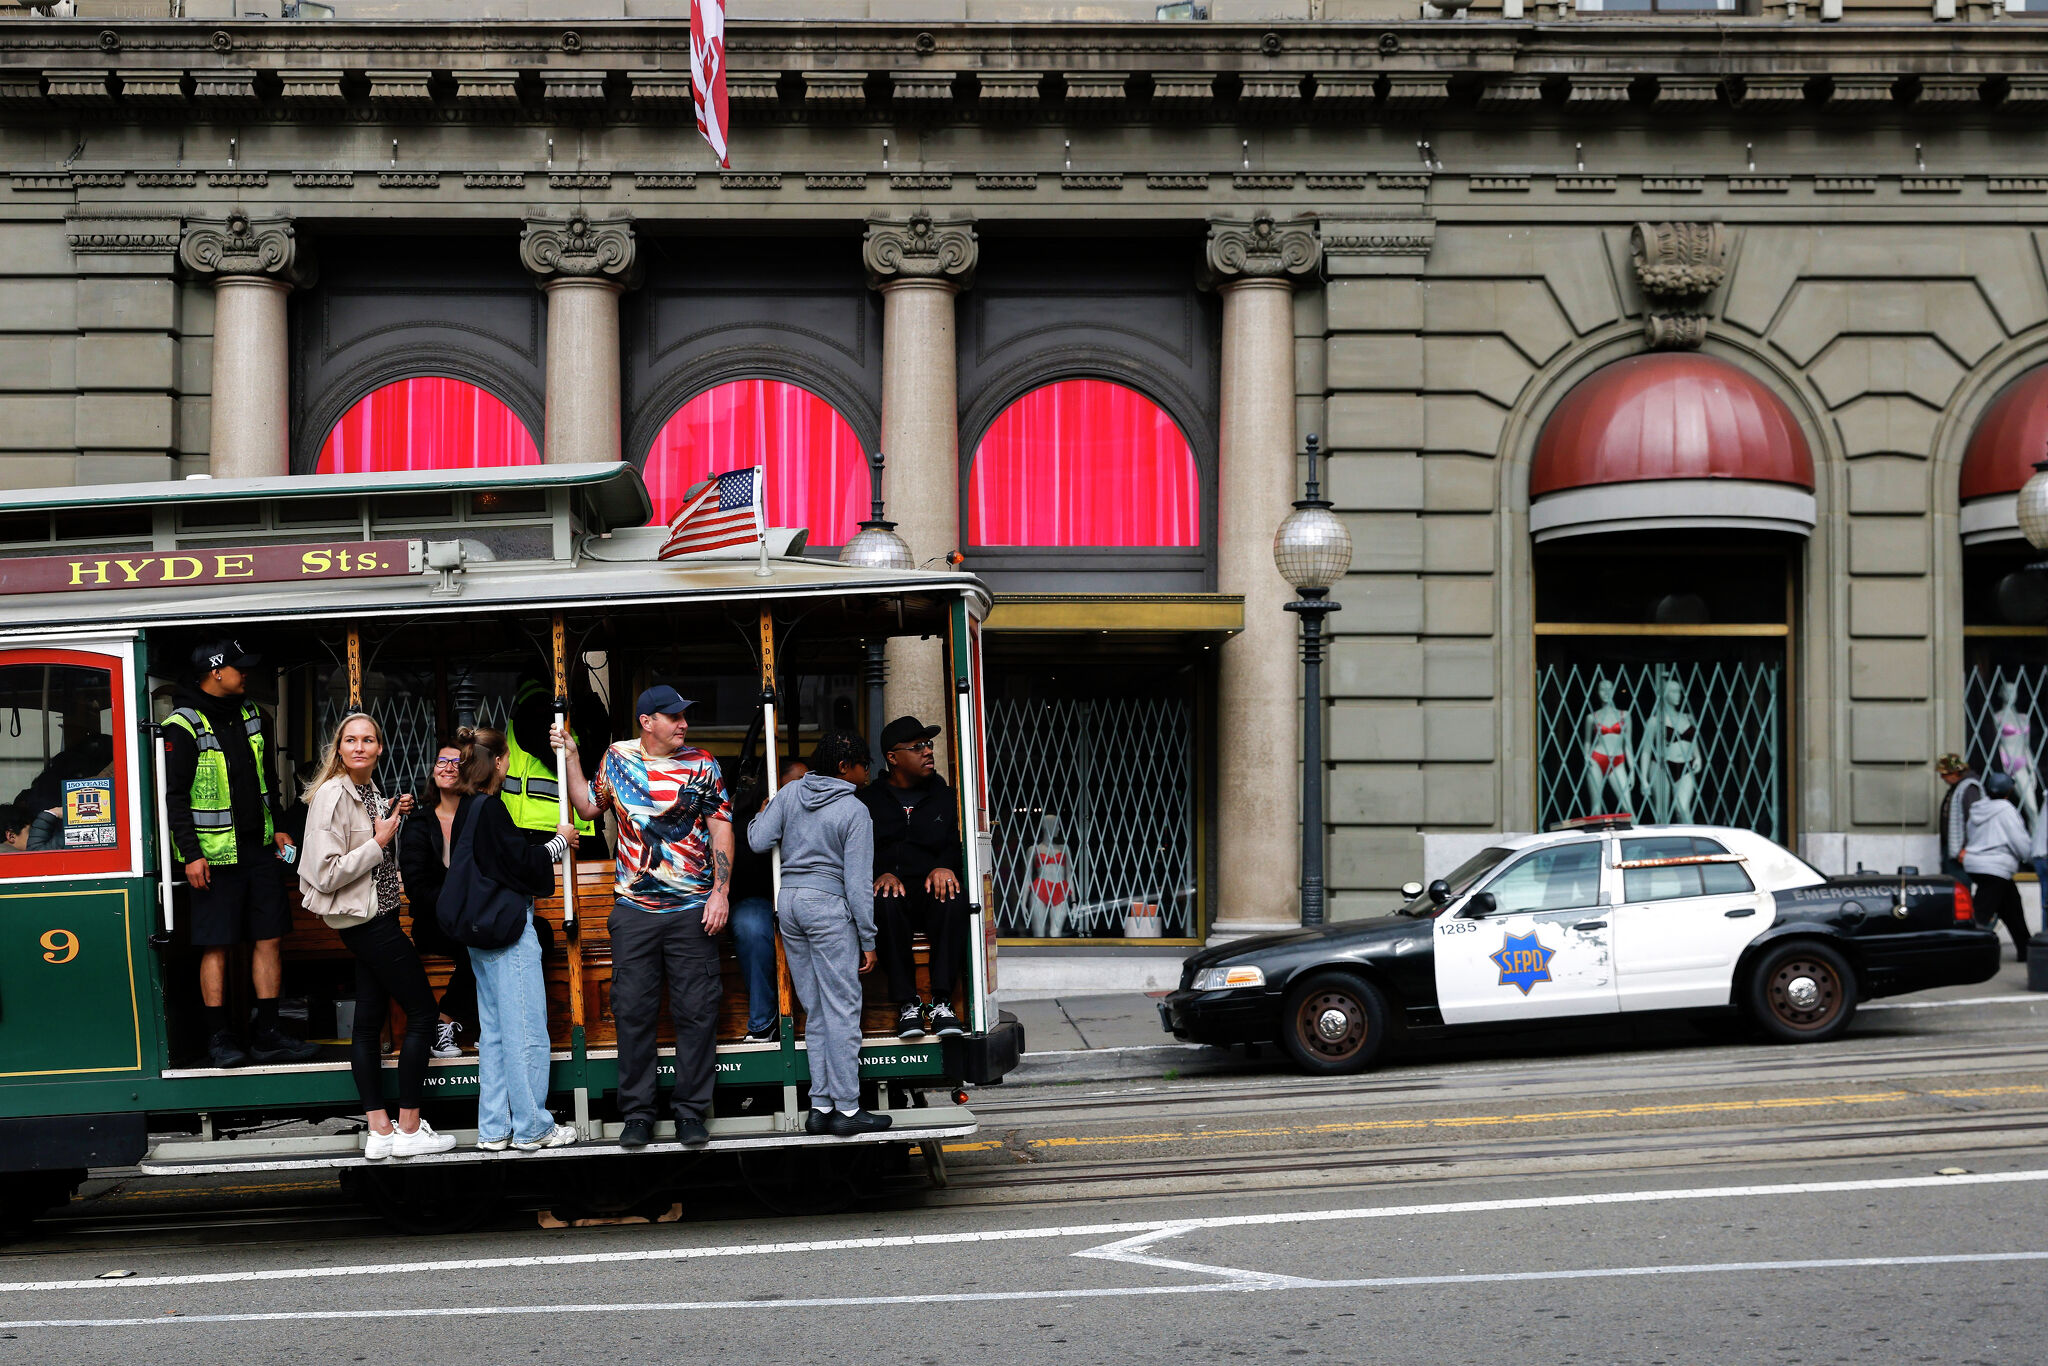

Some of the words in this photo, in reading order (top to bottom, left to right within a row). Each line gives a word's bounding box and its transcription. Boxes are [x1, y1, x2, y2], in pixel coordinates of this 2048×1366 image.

[69, 554, 254, 585] HYDE
[302, 549, 390, 574] Sts.
[209, 653, 224, 667] XV
[558, 671, 564, 691] ON
[1792, 885, 1899, 901] EMERGENCY
[1907, 884, 1936, 896] 911
[1439, 922, 1477, 935] 1285
[40, 929, 80, 964] 9
[1502, 949, 1546, 974] S.F.P.D.
[715, 1063, 742, 1072] ONLY
[858, 1056, 897, 1066] ANDEES
[901, 1054, 929, 1064] ONLY
